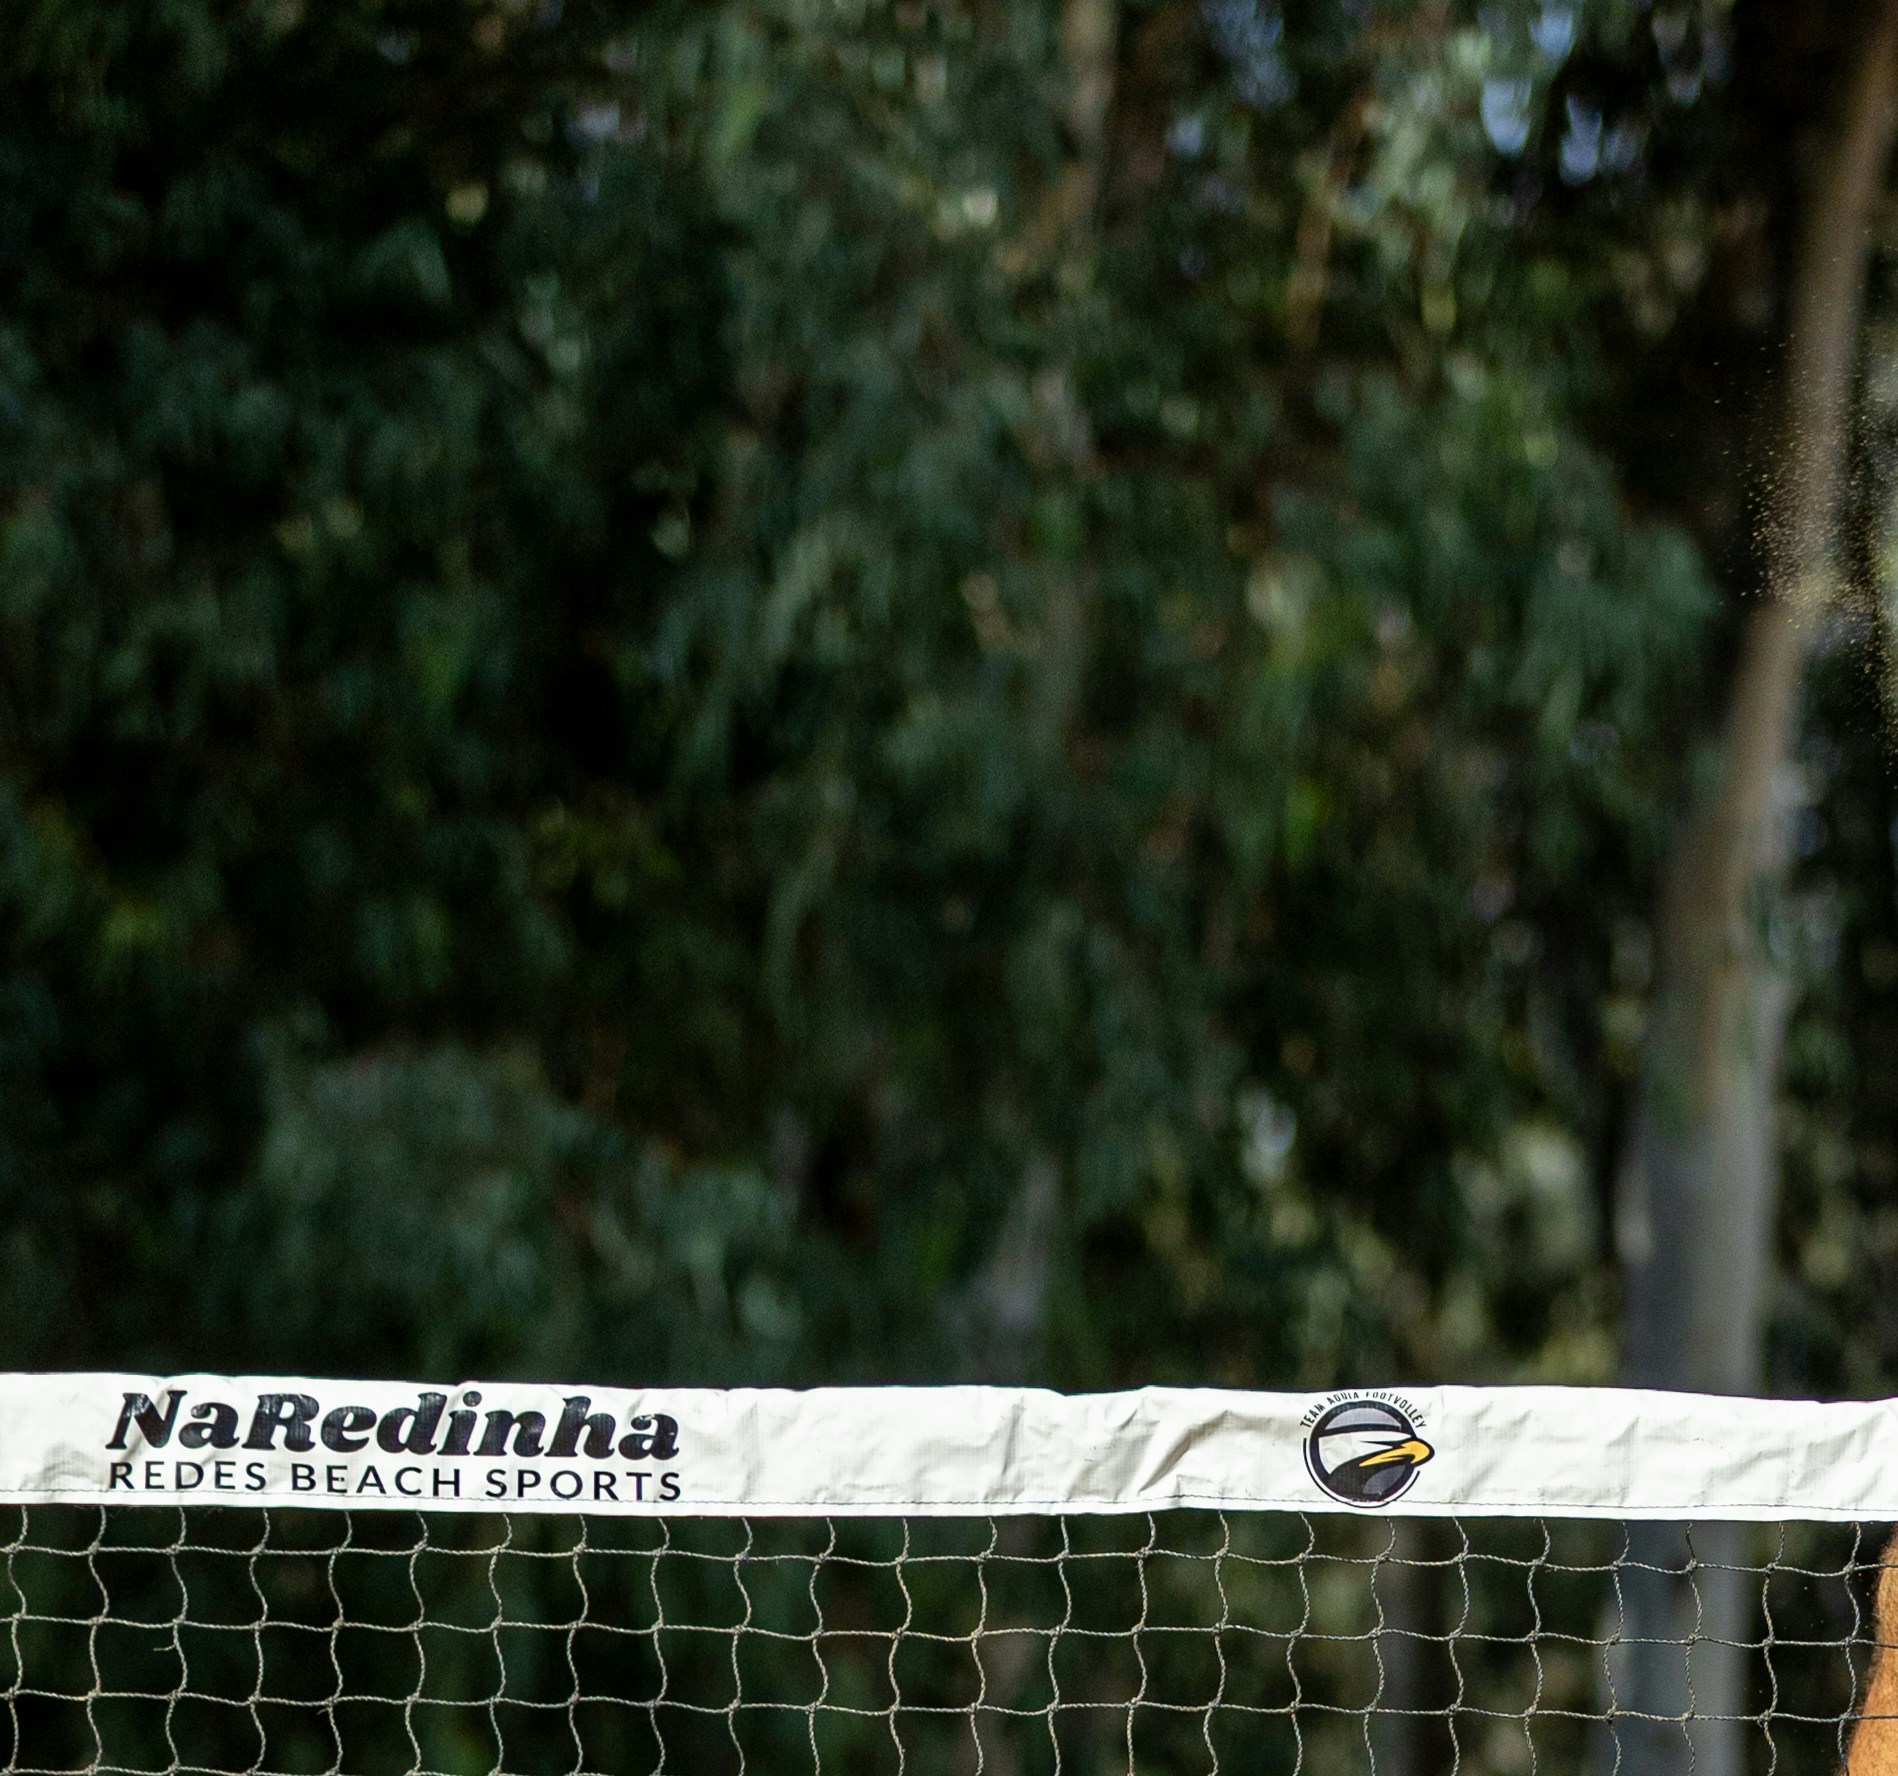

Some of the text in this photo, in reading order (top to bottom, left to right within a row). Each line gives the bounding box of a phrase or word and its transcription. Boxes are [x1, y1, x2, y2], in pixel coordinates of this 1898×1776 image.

[105, 1389, 680, 1461] NaRedinha
[1299, 1402, 1326, 1428] TEAM
[109, 1460, 682, 1501] REDES BEACH SPORTS
